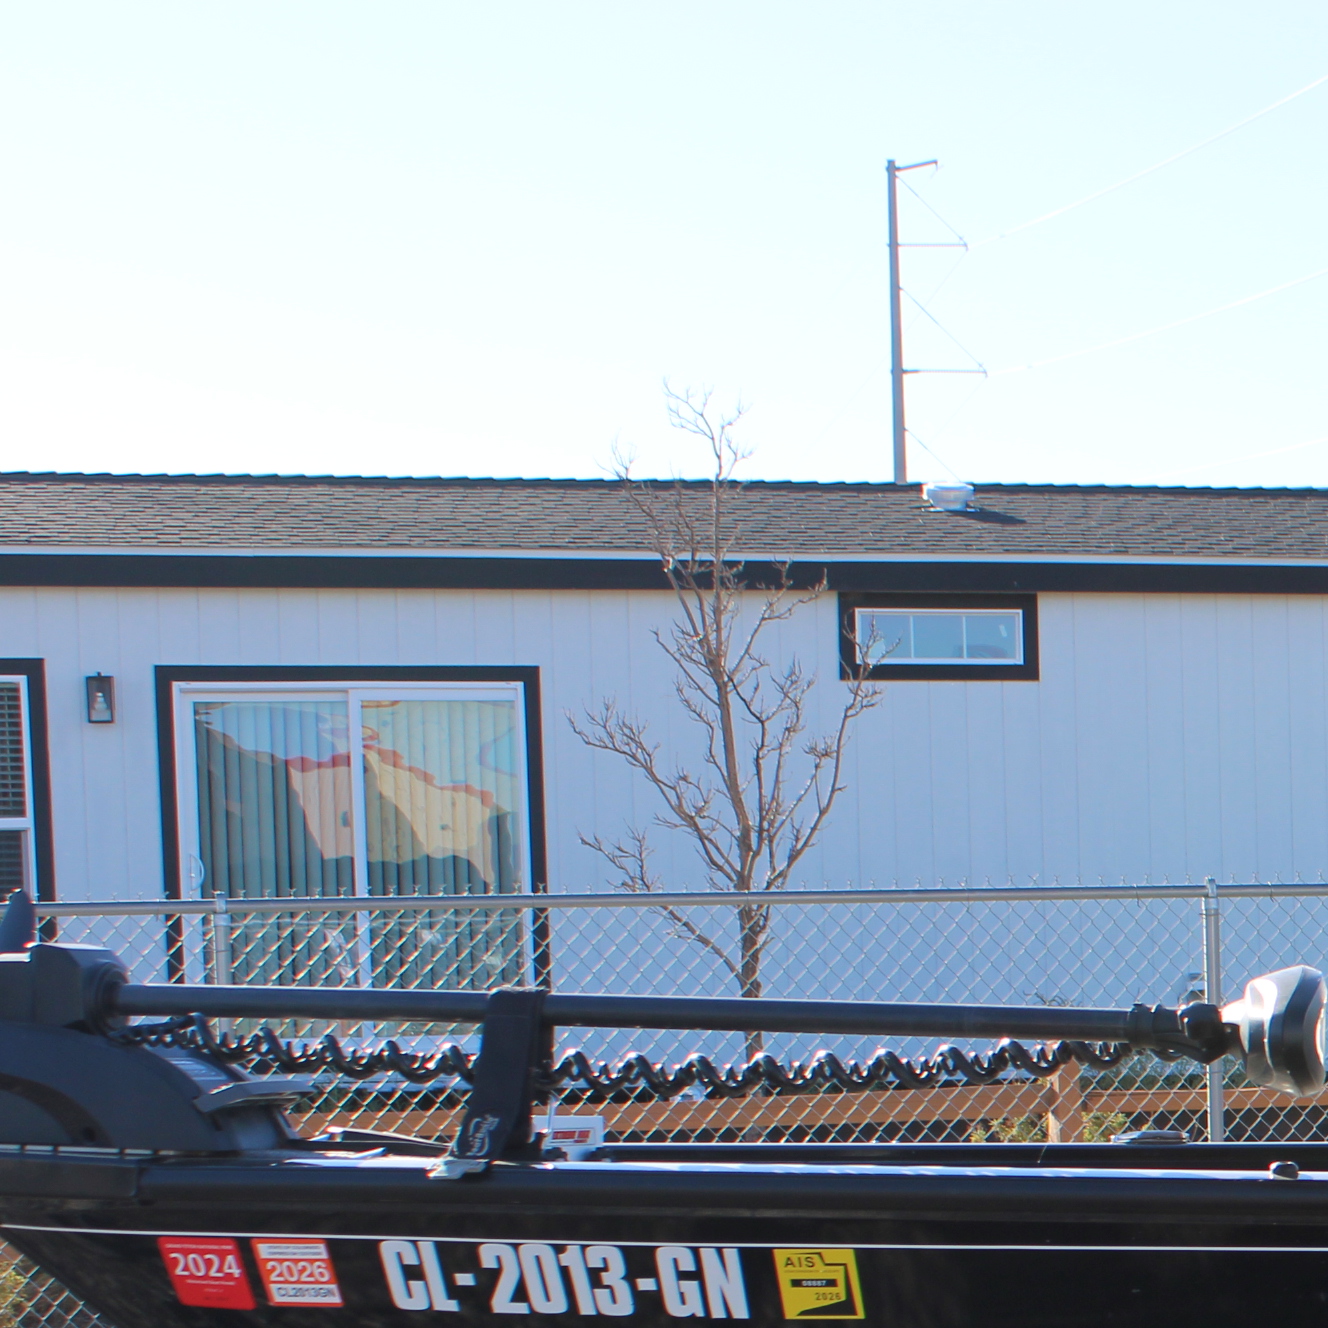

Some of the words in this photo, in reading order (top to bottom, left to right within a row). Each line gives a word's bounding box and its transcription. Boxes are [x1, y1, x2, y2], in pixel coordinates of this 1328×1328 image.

[168, 1252, 242, 1278] 2024
[265, 1261, 332, 1282] 2026
[784, 1256, 816, 1268] AIS
[379, 1240, 750, 1319] CL-2013-GN
[814, 1292, 842, 1301] 2026
